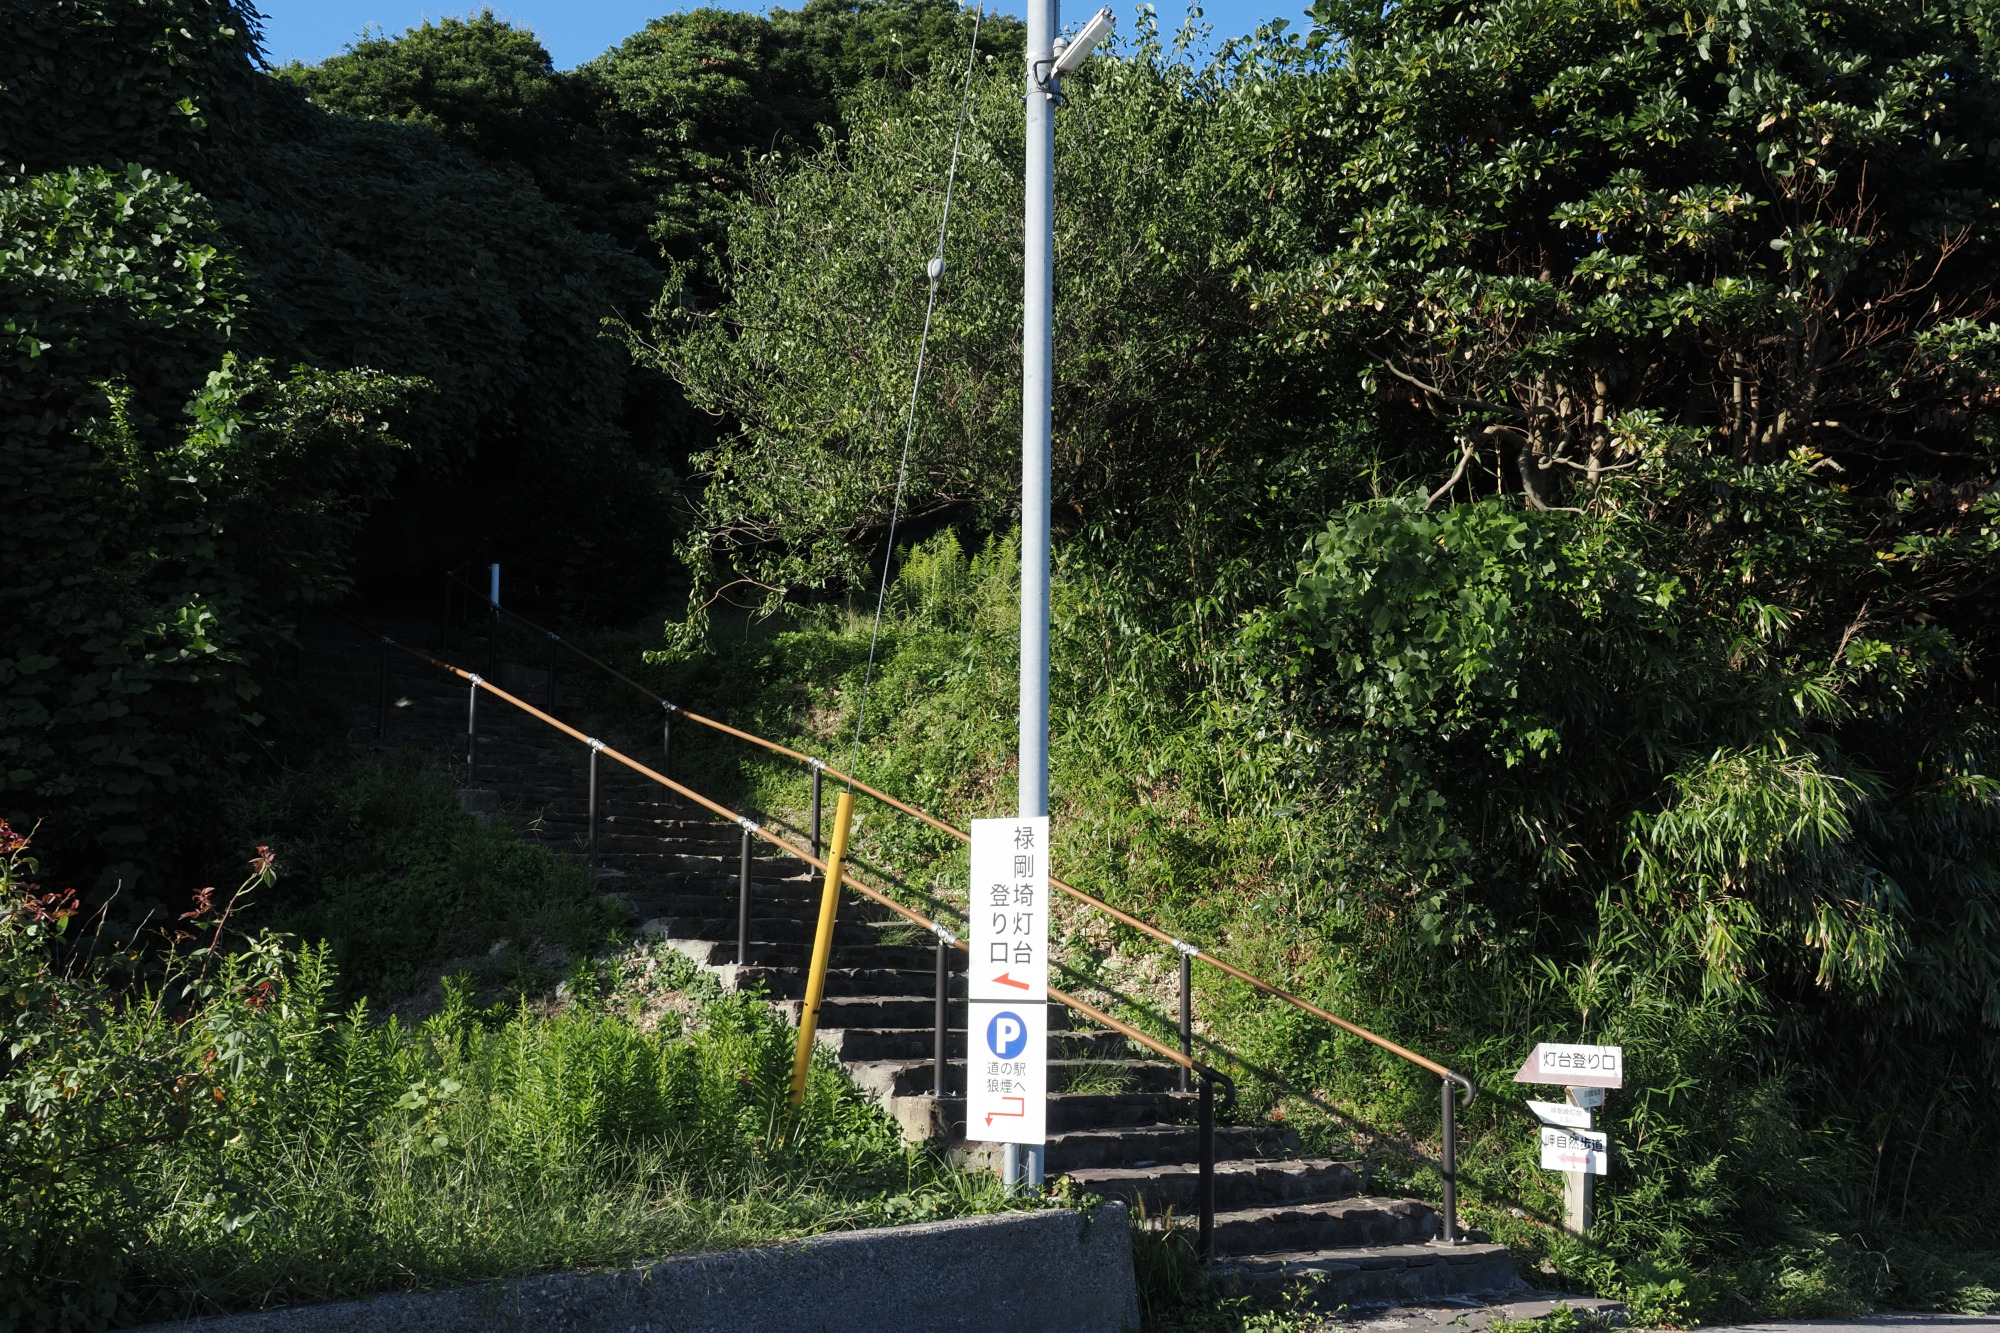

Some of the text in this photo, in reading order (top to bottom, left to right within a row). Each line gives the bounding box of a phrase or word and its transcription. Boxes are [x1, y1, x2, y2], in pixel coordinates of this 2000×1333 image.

[990, 884, 1010, 963] 登り口
[996, 1018, 1020, 1054] P
[987, 1061, 1026, 1076] 道の駅
[1543, 1051, 1615, 1070] 灯台登り口
[986, 1078, 1026, 1093] 狼煙へ
